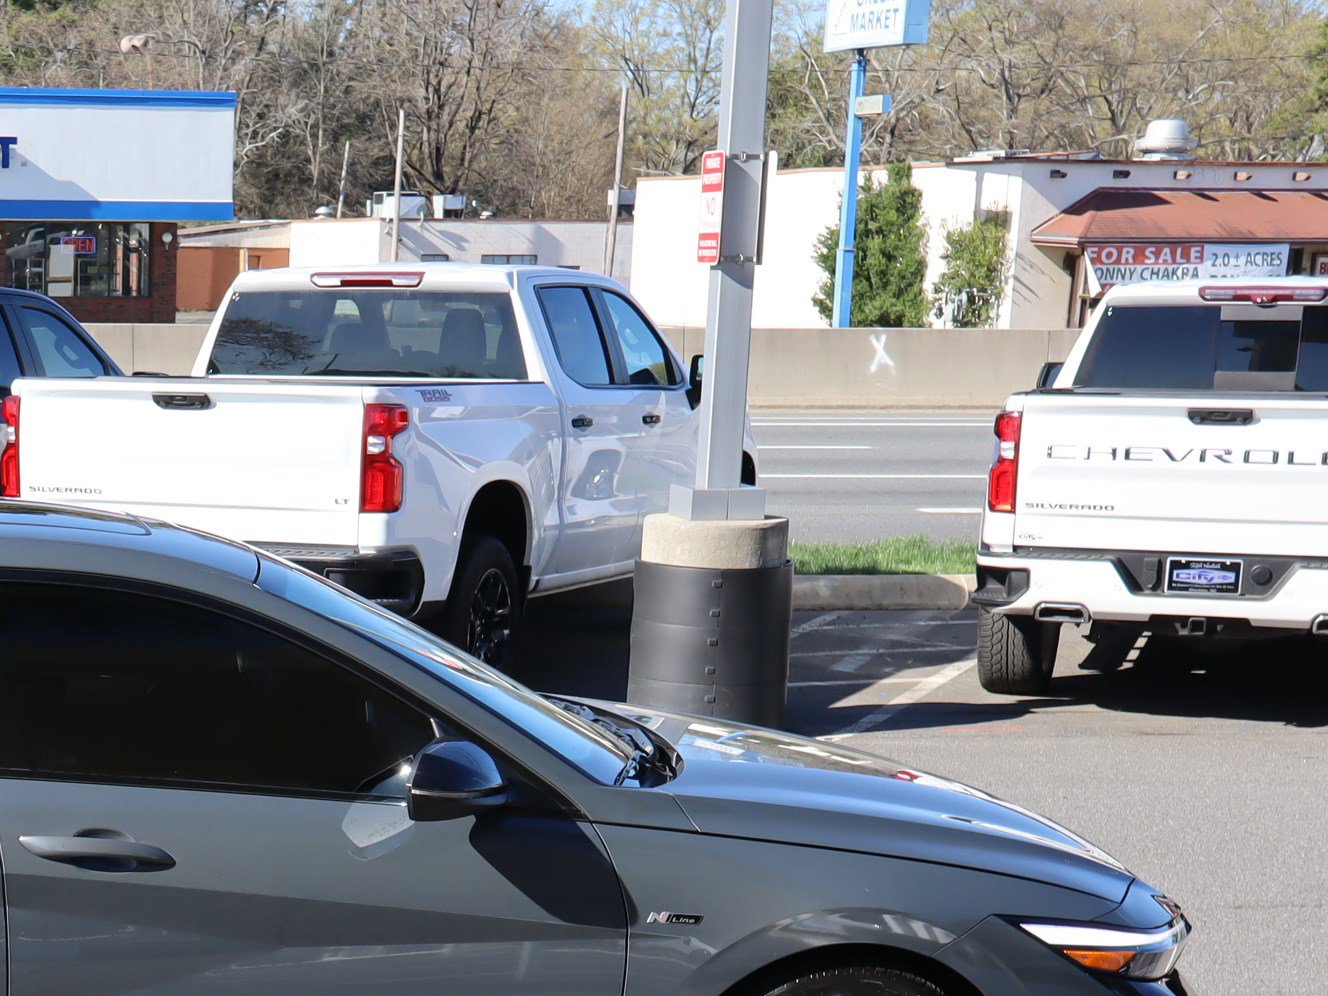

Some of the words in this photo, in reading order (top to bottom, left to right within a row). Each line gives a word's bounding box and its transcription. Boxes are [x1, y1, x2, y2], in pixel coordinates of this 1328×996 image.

[850, 8, 899, 32] MARKET
[706, 197, 716, 215] NO
[63, 237, 95, 252] OPEN
[1087, 247, 1135, 264] FOR
[1144, 247, 1202, 264] SALE
[1211, 253, 1230, 267] 2.0
[1245, 252, 1283, 267] ACRES
[1094, 267, 1136, 281] ONNY
[414, 389, 453, 397] TRAIL
[1047, 444, 1328, 466] CHEVROL
[29, 485, 103, 495] SILVERADO
[1025, 502, 1115, 511] SILVERADO
